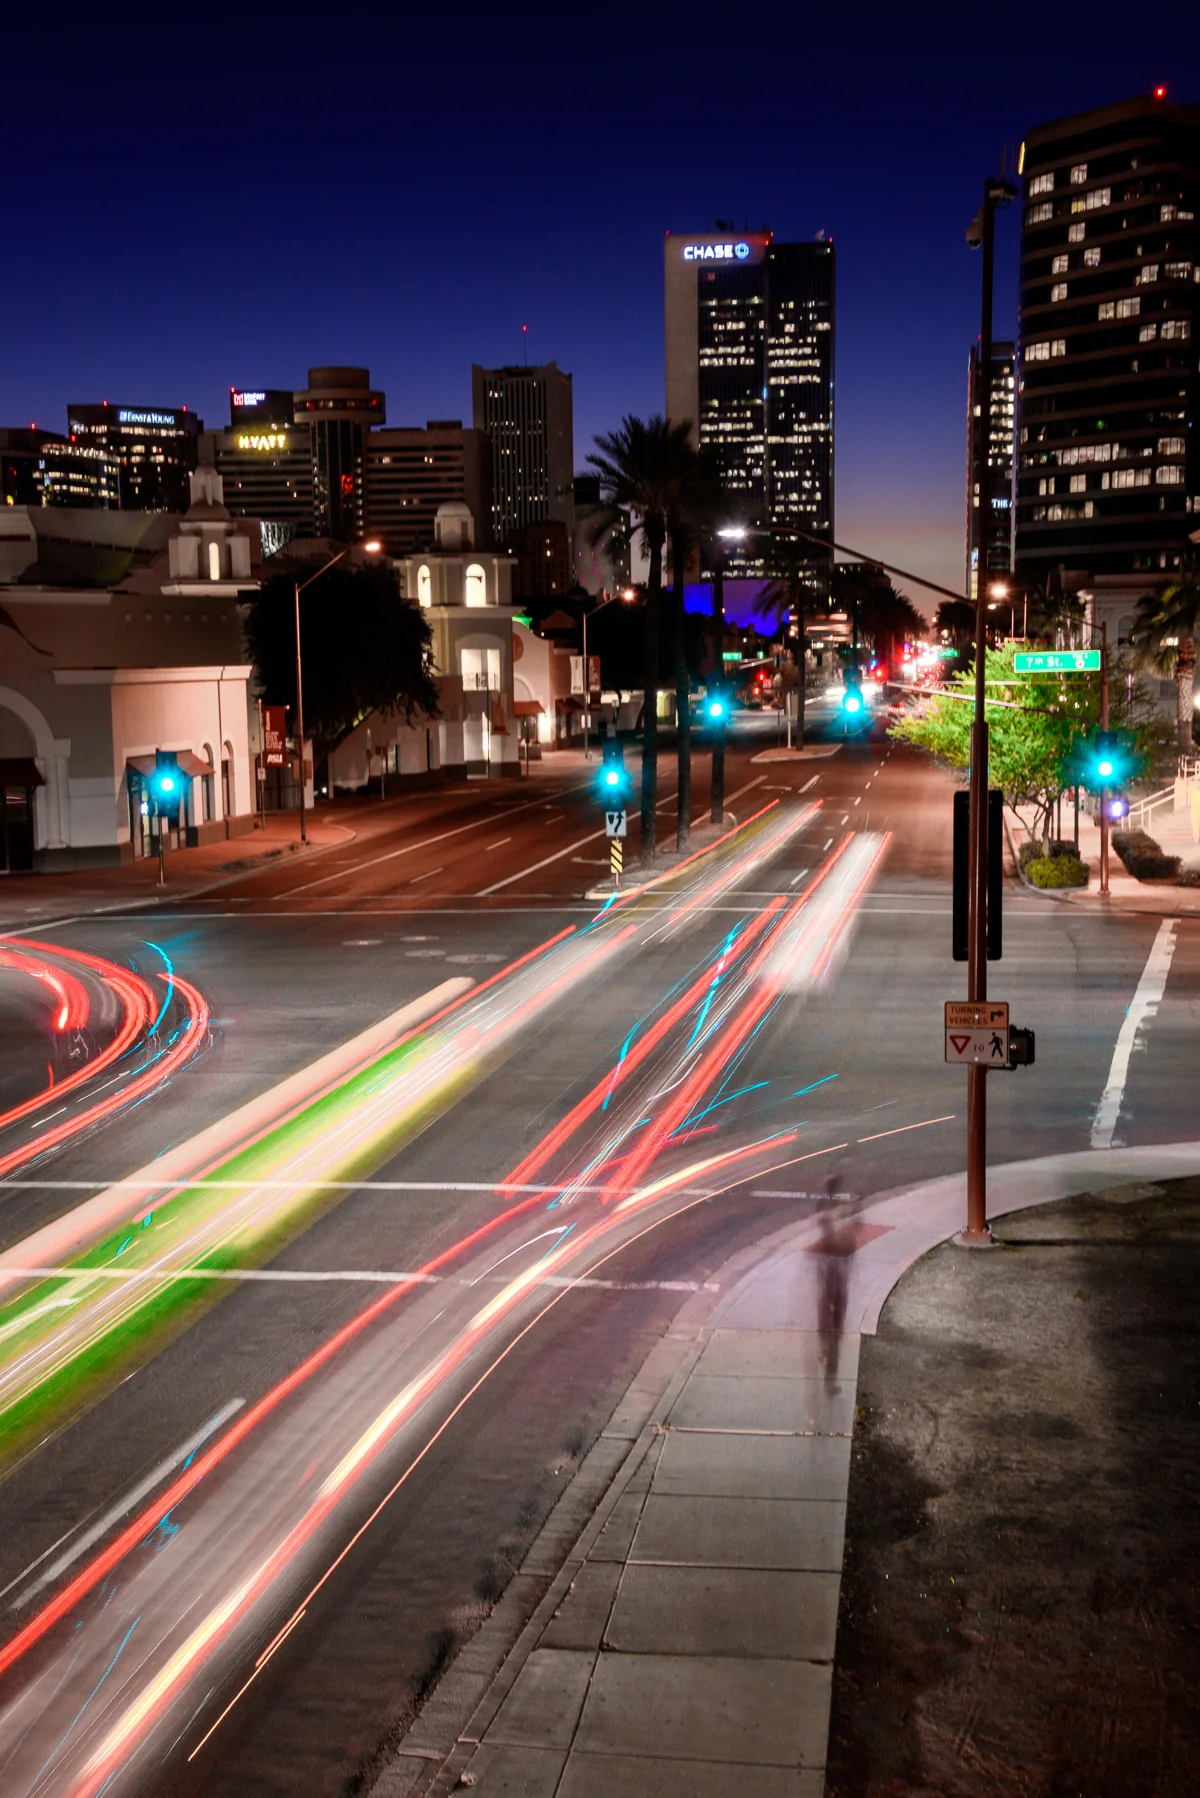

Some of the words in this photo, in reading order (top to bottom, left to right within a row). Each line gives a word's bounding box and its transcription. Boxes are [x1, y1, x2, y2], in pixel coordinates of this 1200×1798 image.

[684, 244, 733, 259] CHASE
[239, 435, 286, 450] HYATT
[951, 1006, 987, 1014] TURNING
[949, 1016, 988, 1025] VEHICLES
